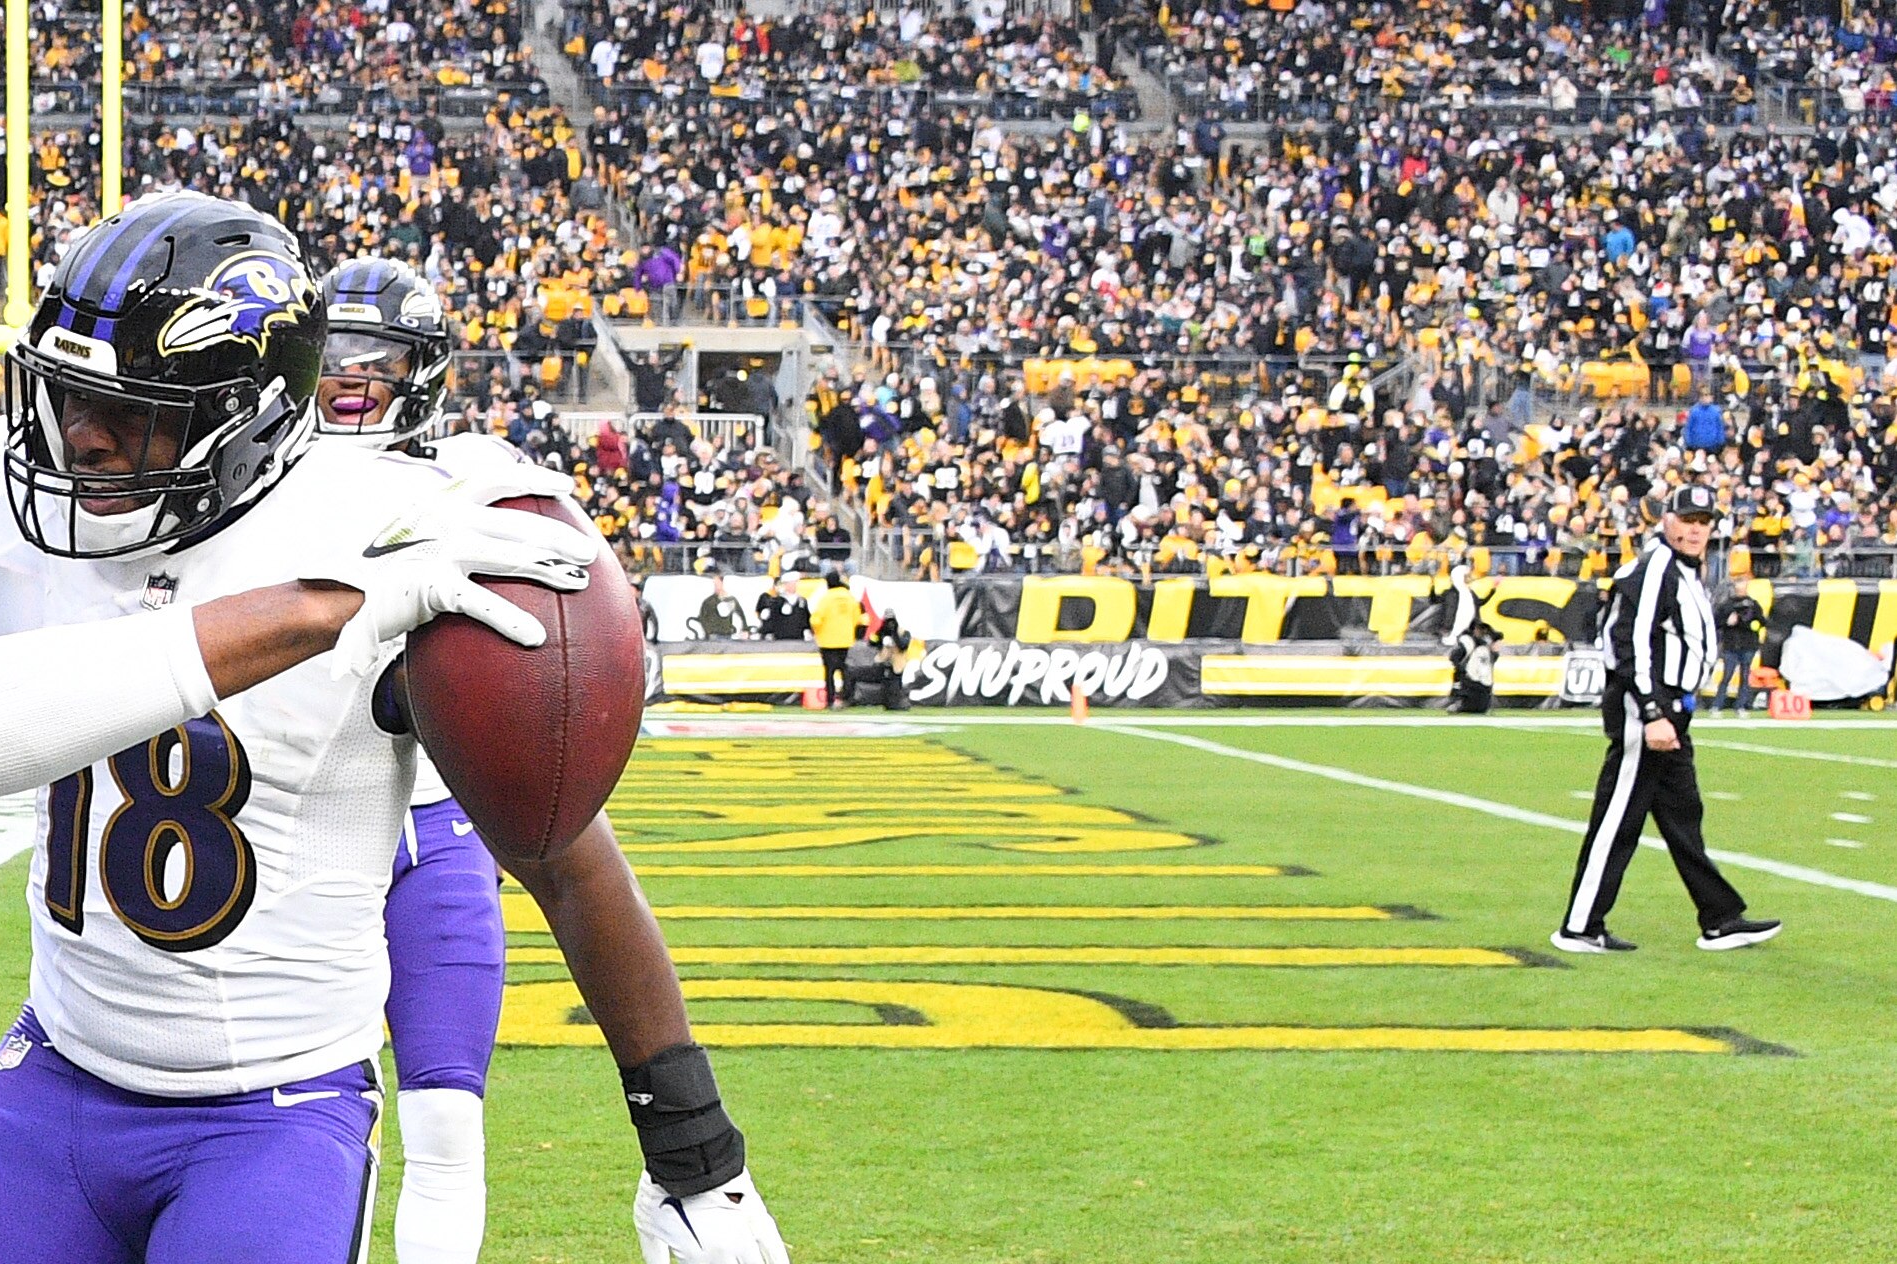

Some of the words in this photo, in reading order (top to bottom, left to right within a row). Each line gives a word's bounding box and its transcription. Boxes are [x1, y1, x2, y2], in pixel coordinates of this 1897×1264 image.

[54, 335, 92, 360] RAVENS
[1780, 695, 1804, 714] 10
[44, 708, 257, 953] 18
